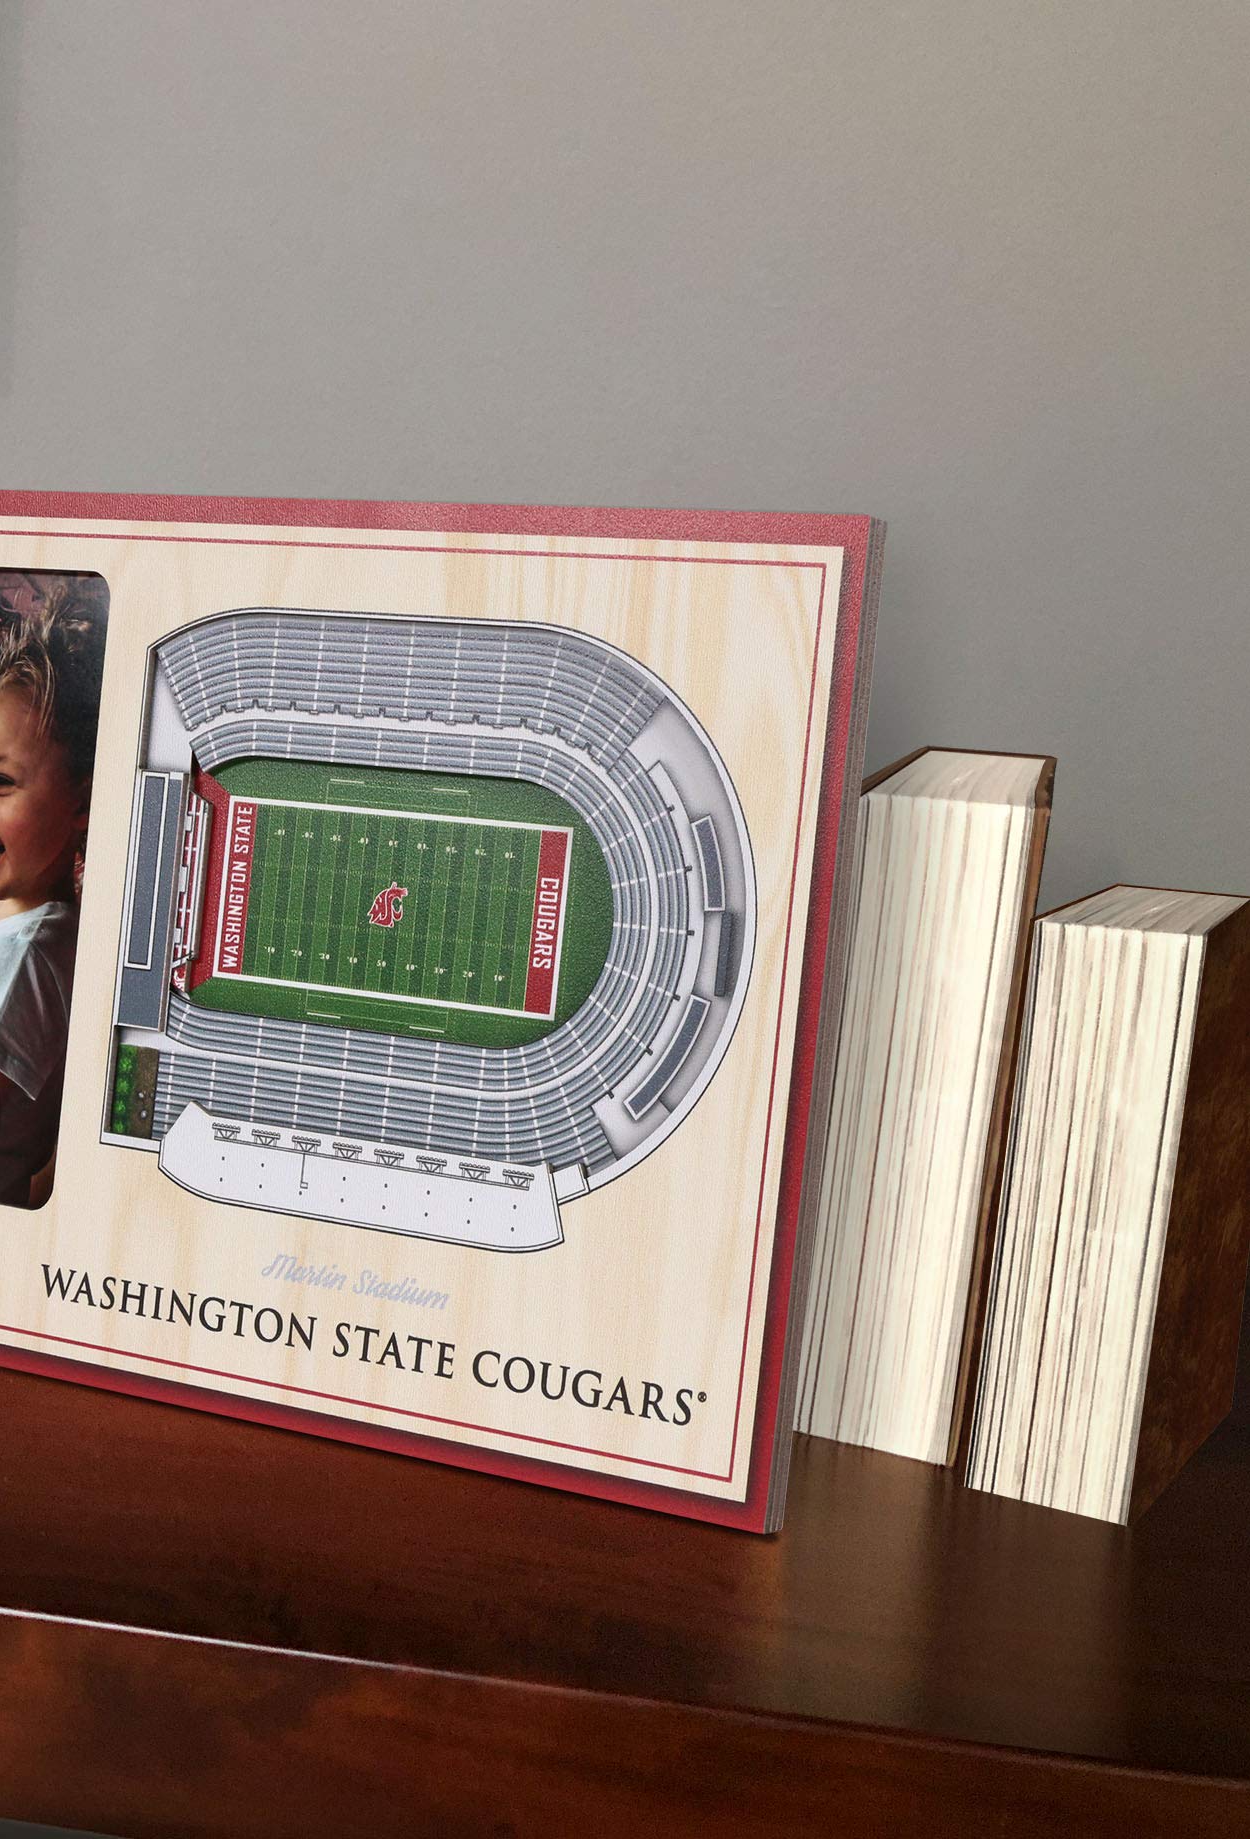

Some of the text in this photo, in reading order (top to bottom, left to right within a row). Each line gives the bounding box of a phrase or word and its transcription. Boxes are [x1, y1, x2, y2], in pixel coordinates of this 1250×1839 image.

[222, 805, 253, 969] WASHINGTON STATE
[532, 877, 560, 969] COUGARS
[41, 1263, 318, 1352] WASHINGTON
[331, 1321, 456, 1380] STATE
[261, 1253, 450, 1310] Martin Stadium
